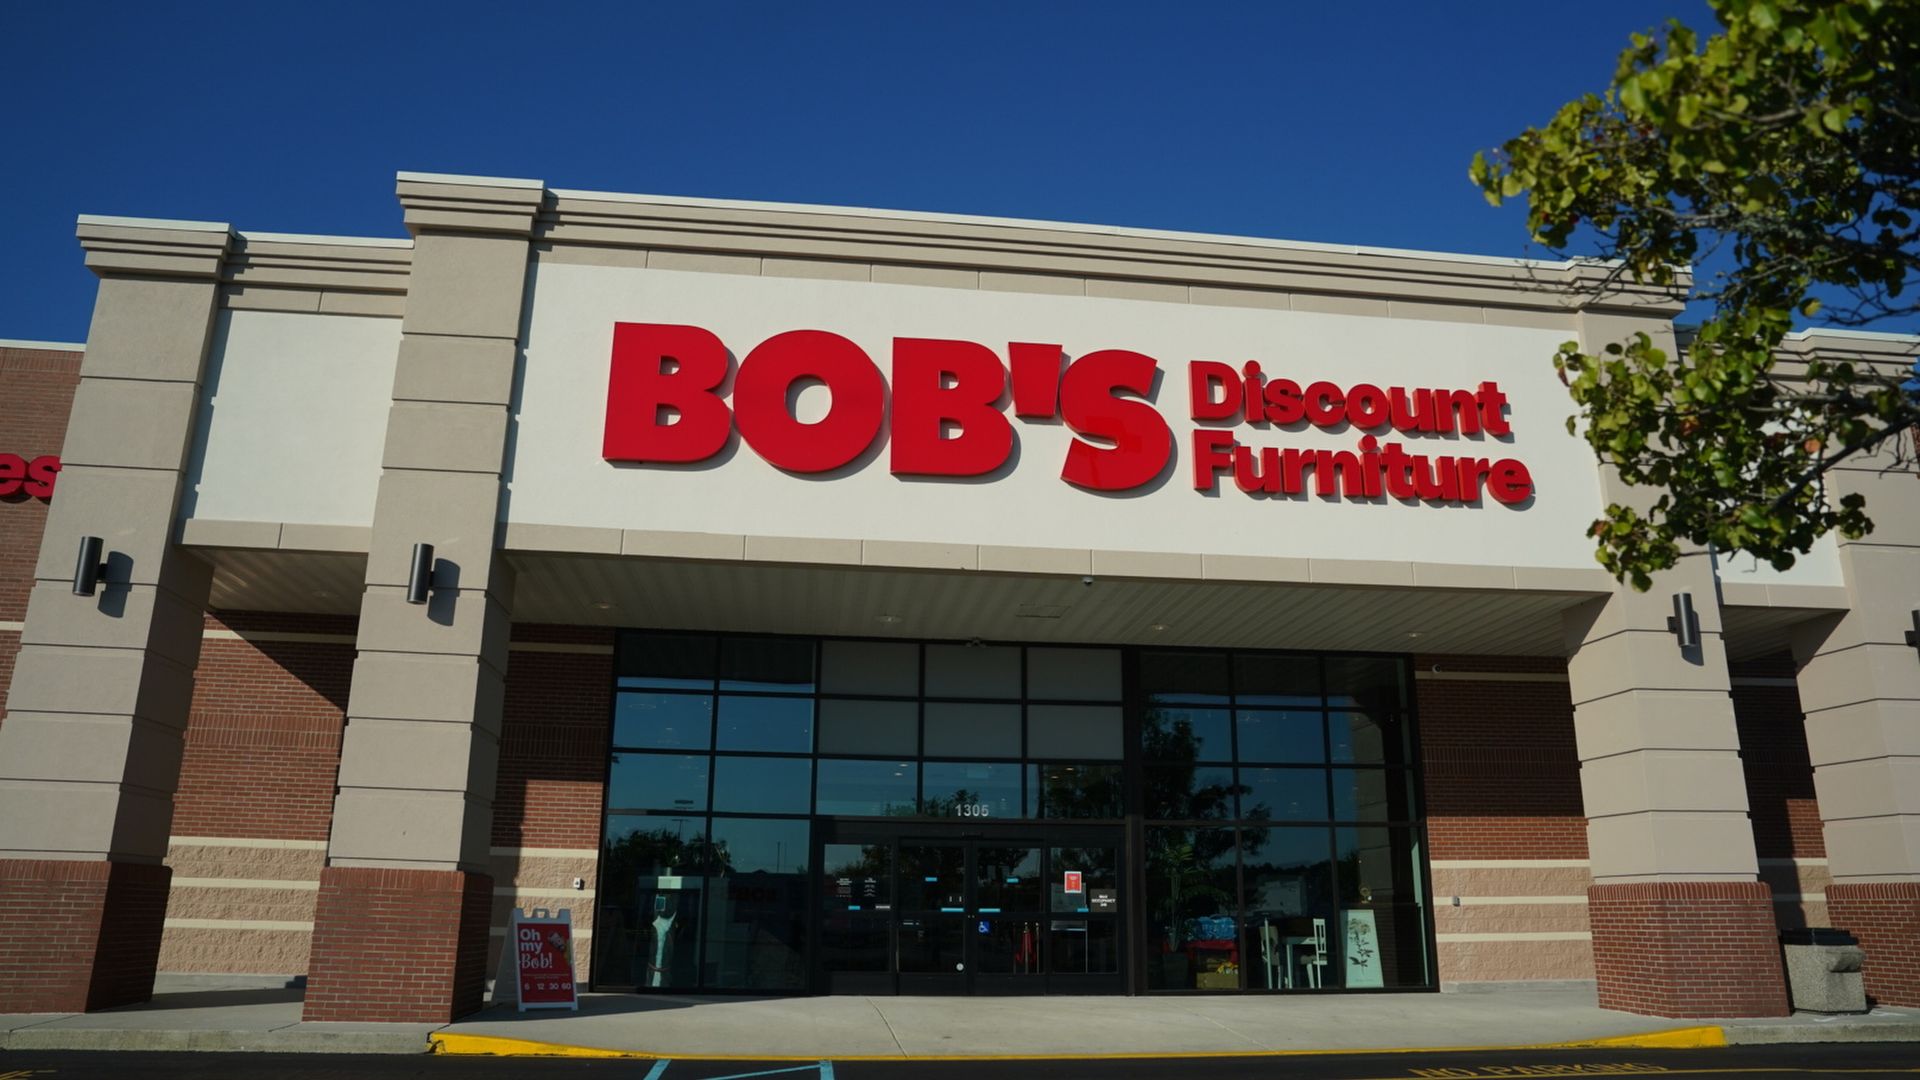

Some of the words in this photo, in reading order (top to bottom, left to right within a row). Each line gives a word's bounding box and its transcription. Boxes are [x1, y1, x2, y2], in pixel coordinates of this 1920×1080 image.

[1189, 359, 1511, 436] Discount
[602, 321, 1171, 491] BOB'S
[1193, 429, 1533, 505] Furniture
[955, 803, 989, 817] 1305
[520, 928, 541, 941] Oh
[520, 942, 543, 954] my
[521, 953, 553, 969] Bob!
[537, 982, 545, 990] 12
